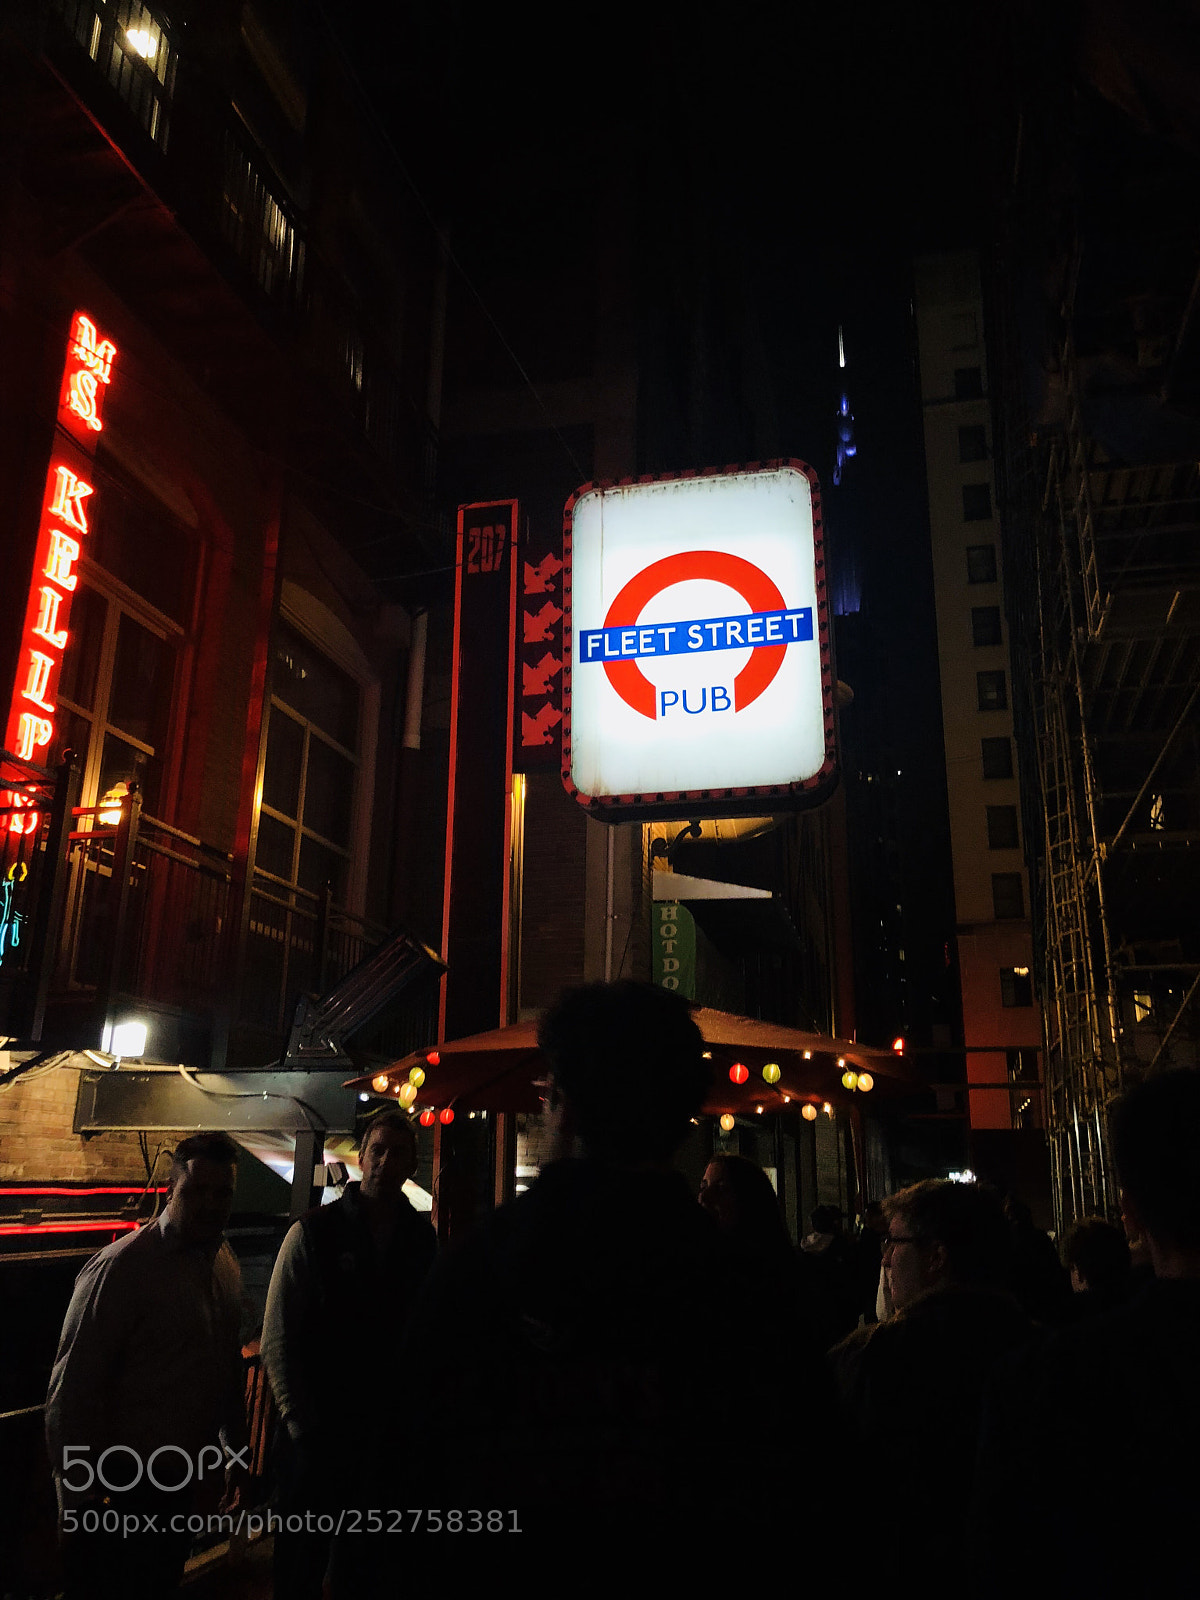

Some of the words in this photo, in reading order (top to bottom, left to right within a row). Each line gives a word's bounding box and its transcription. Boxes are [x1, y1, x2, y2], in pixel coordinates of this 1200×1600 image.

[467, 524, 506, 574] 207
[586, 627, 676, 658] FLEET
[687, 613, 805, 650] STREET
[660, 686, 732, 717] PUB
